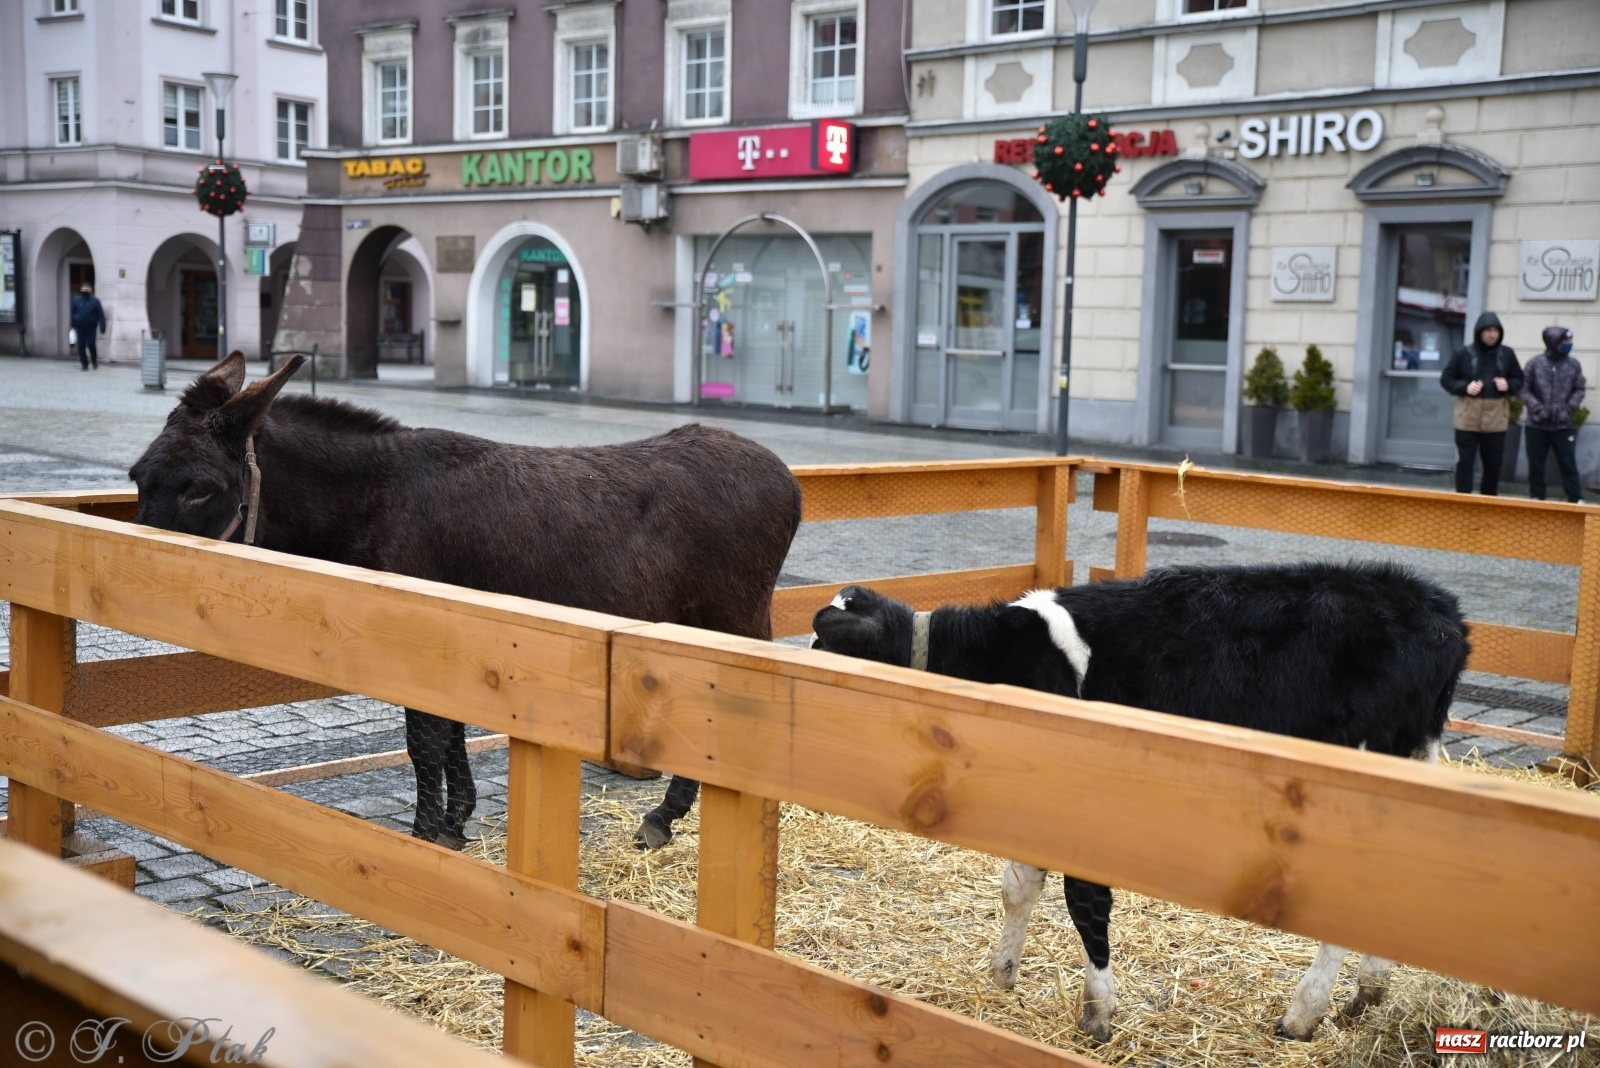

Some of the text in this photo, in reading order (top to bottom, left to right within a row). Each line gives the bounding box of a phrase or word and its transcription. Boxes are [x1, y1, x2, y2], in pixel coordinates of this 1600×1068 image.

[826, 125, 848, 165] T
[1238, 108, 1384, 159] SHIRO
[343, 157, 425, 178] TABAC
[461, 147, 594, 187] KANTOR
